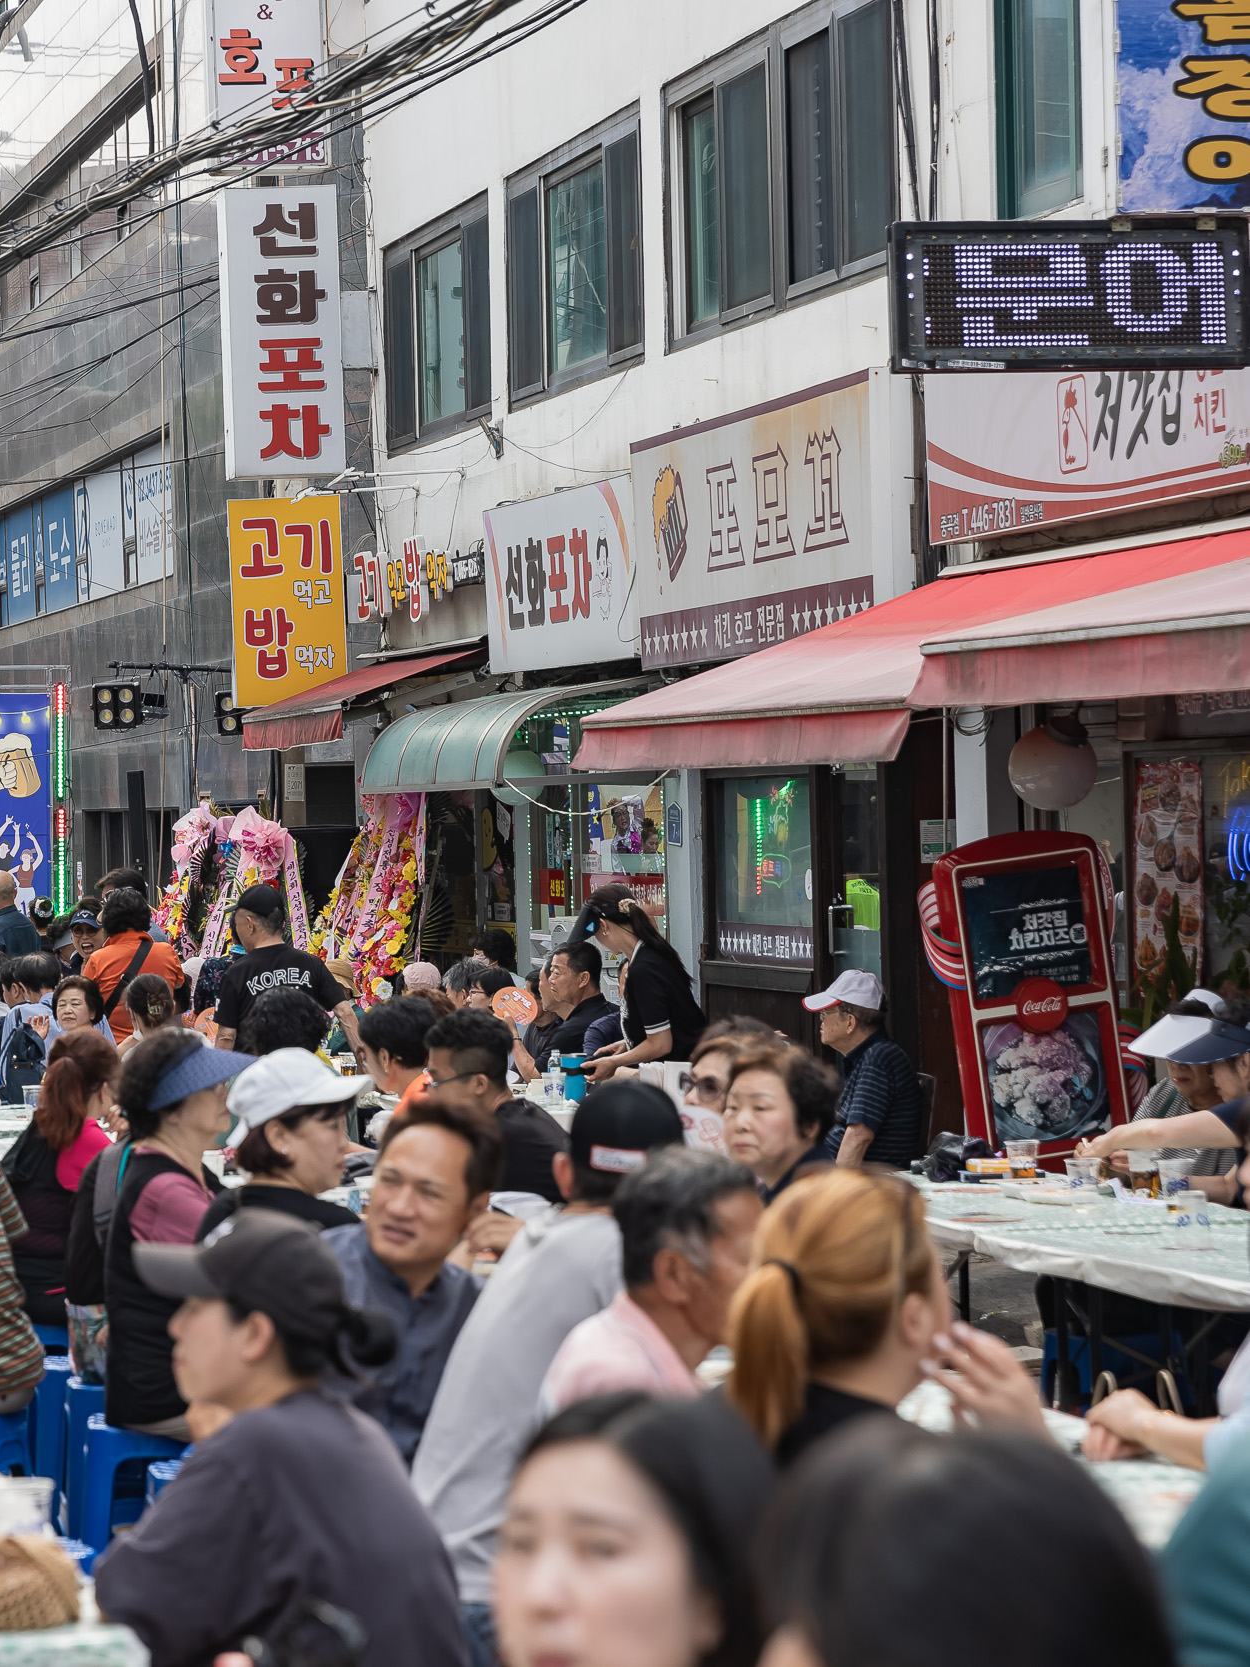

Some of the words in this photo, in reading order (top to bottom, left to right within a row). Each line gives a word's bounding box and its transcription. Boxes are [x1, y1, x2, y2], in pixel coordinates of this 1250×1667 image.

[953, 243, 1227, 347] 문어
[253, 202, 332, 460] 선화포차
[1193, 388, 1227, 437] 치킨
[940, 512, 960, 538] 중곡점
[961, 498, 1016, 536] T.446-7831
[10, 533, 31, 598] 물리
[48, 517, 72, 583] 도수
[240, 517, 334, 580] 고기
[293, 579, 333, 609] 먹고
[352, 552, 385, 620] 고기
[386, 558, 407, 609] 먹고
[402, 536, 422, 622] 밥
[425, 549, 449, 600] 먹자
[505, 527, 593, 631] 선화포차
[244, 606, 296, 681] 밥
[713, 610, 732, 650] 치킨
[734, 609, 754, 643] 호프
[756, 601, 786, 644] 전문점
[294, 643, 336, 674] 먹자
[1022, 909, 1068, 931] 처갓집
[762, 934, 773, 957] 호프
[774, 934, 791, 960] 전문점
[246, 968, 312, 996] KOREA
[1022, 996, 1063, 1016] Coca-Cola
